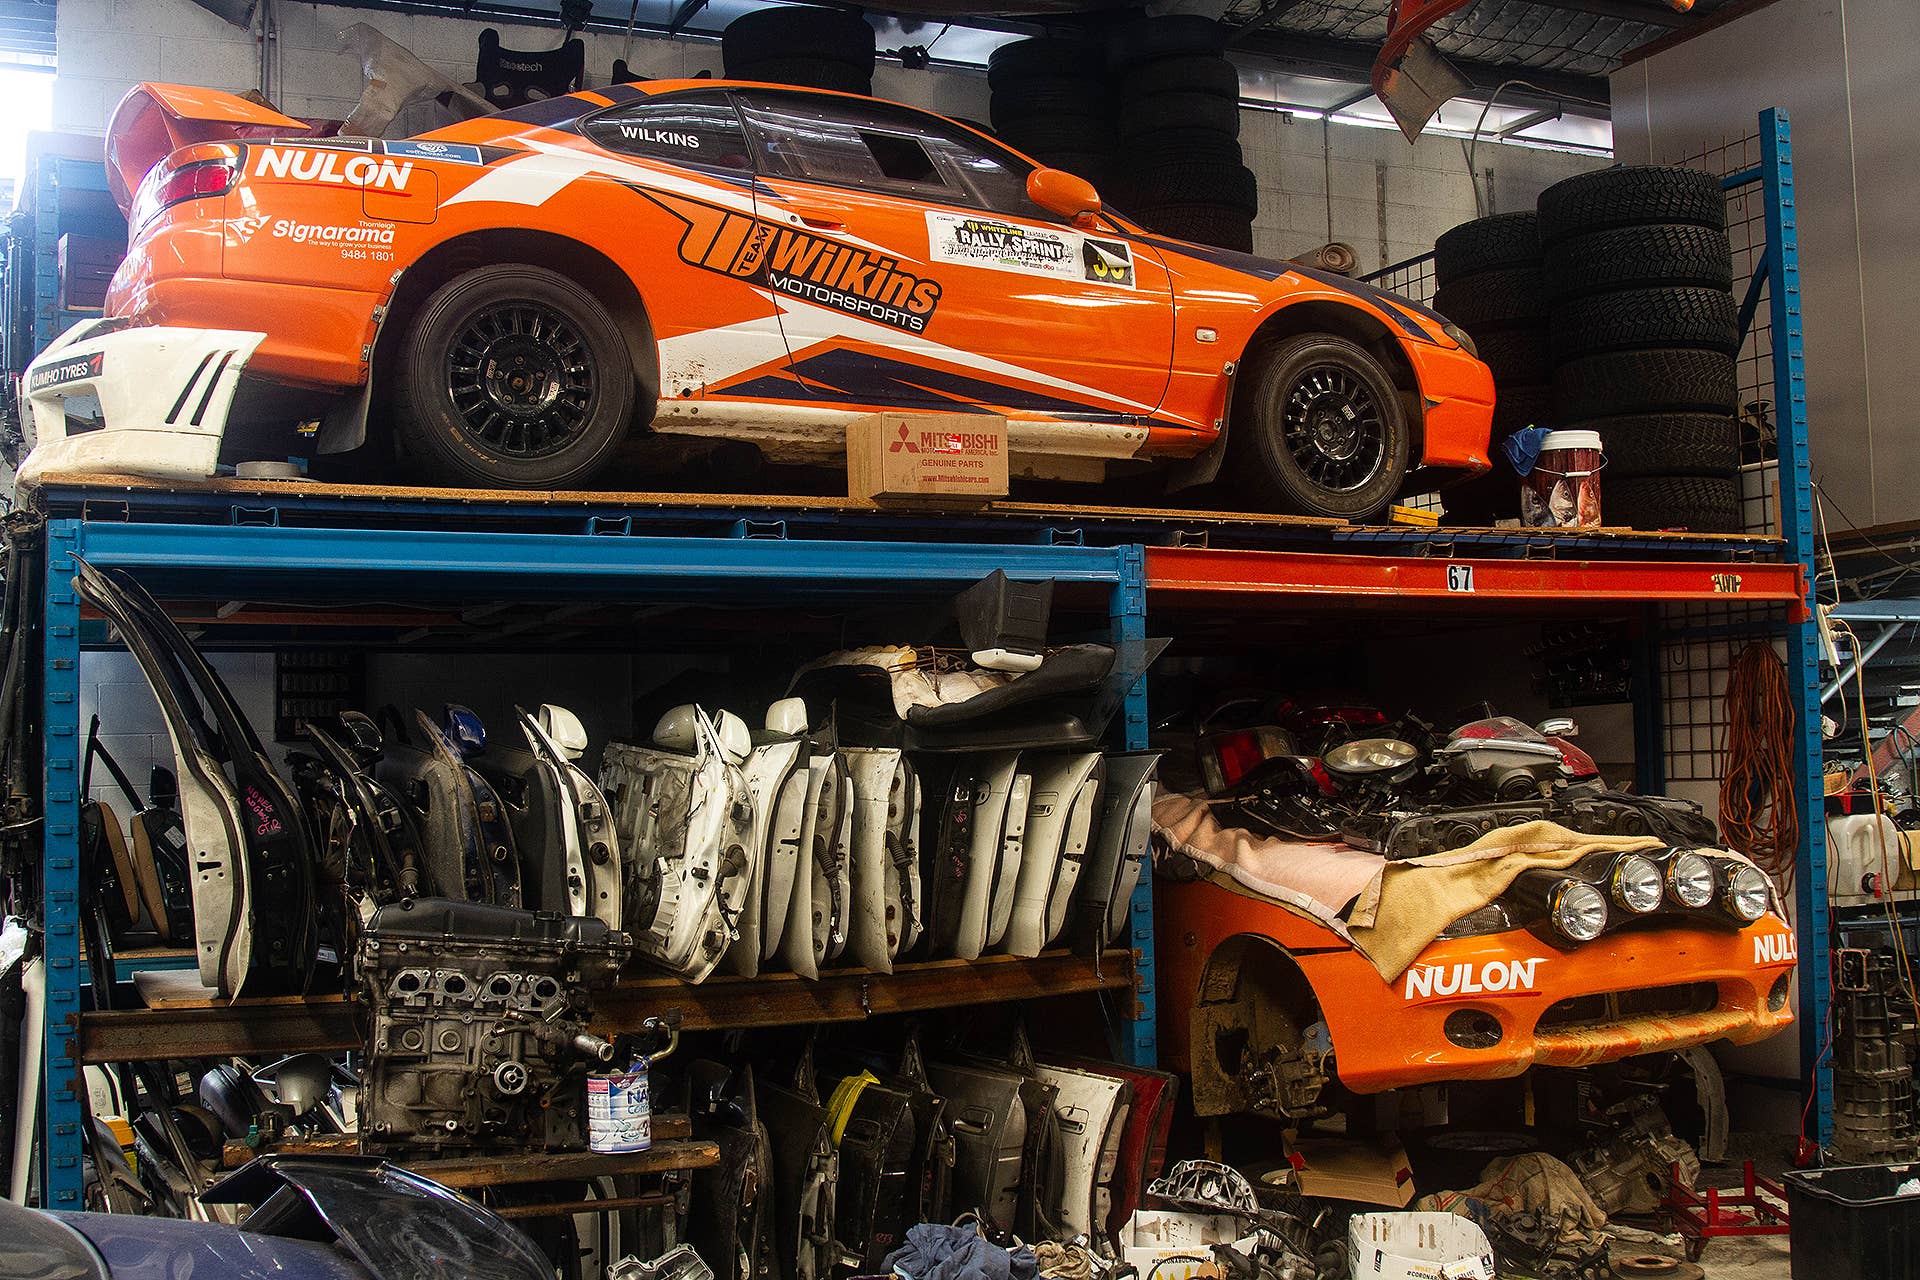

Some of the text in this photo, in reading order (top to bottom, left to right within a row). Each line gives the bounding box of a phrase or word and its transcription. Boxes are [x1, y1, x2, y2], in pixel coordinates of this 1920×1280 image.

[620, 125, 700, 149] WILKINS
[254, 148, 414, 190] NULON
[272, 219, 395, 244] Signarama
[358, 220, 396, 230] Thornleigh
[980, 224, 1023, 237] WHITELINE
[341, 249, 395, 262] 9484 1801
[737, 226, 771, 272] TEAM
[960, 229, 1062, 259] RALLY SPRINT
[771, 229, 940, 314] Wilkins
[769, 272, 924, 331] MOTORSPORTS
[31, 361, 89, 388] KUMHO TYRES
[921, 431, 998, 450] MITSBISHI
[922, 459, 984, 469] GENUINE PARTS
[1448, 565, 1471, 591] 67
[1404, 960, 1536, 1000] NULON
